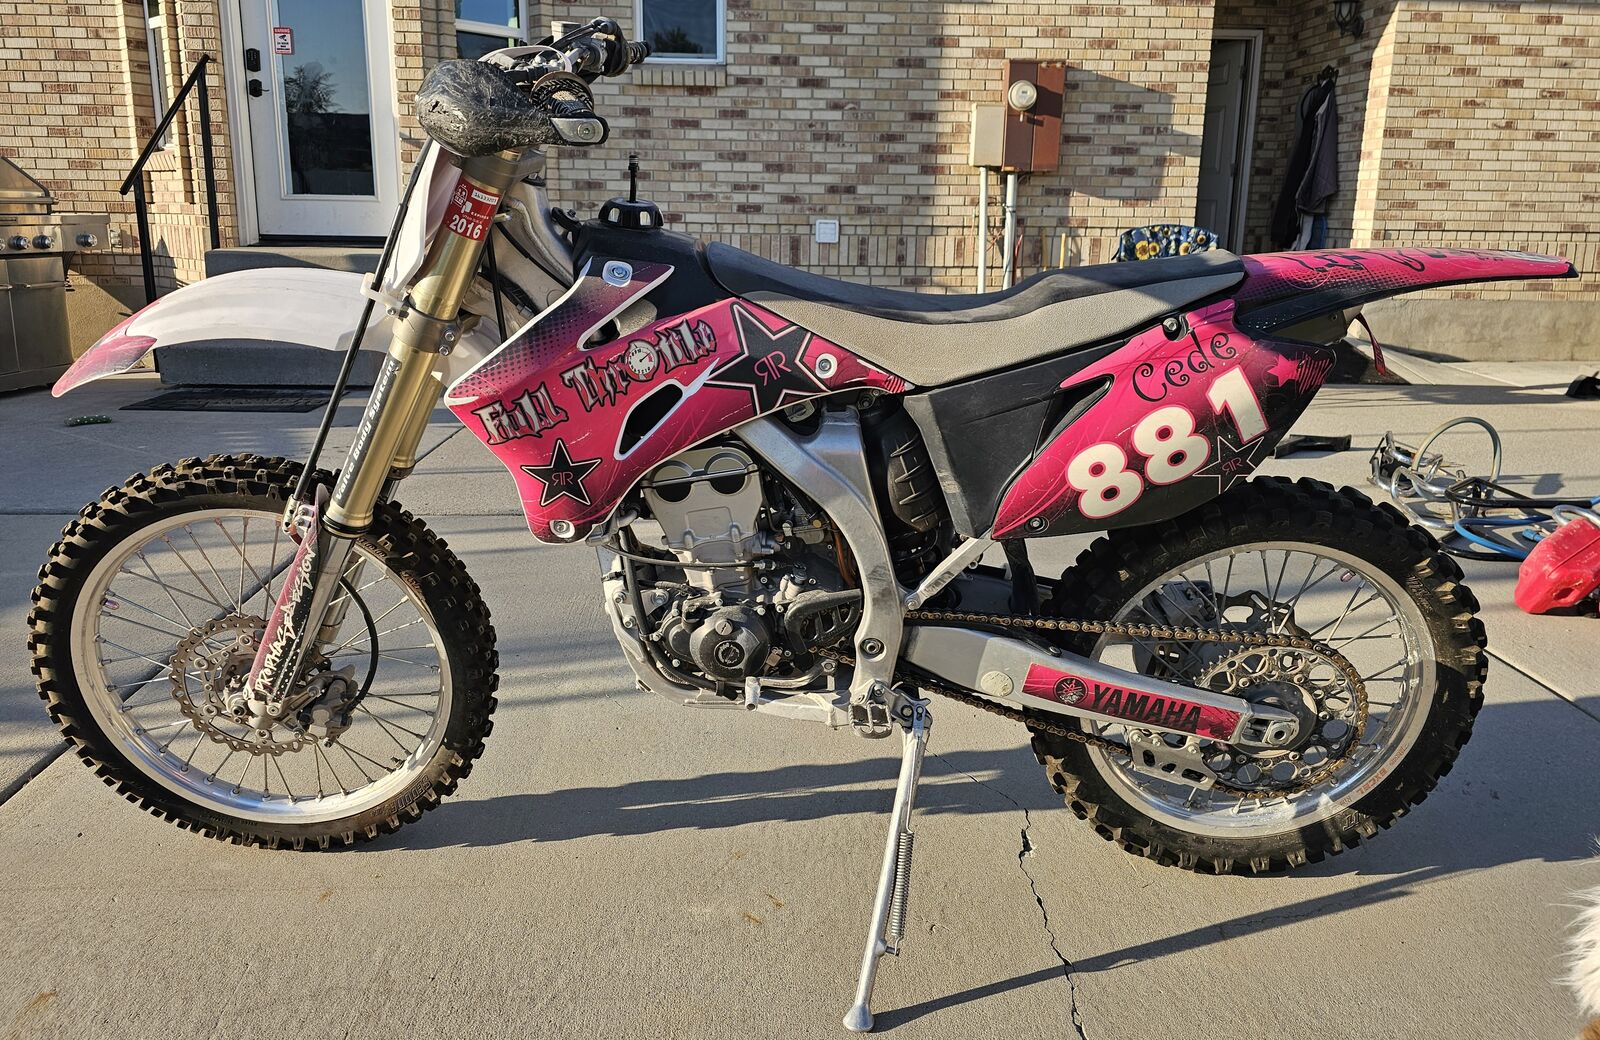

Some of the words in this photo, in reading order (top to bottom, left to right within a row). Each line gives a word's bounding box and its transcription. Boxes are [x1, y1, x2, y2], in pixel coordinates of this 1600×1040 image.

[449, 214, 483, 239] 2016
[1132, 328, 1237, 402] Cede
[335, 462, 356, 501] Valve
[352, 420, 373, 462] Body
[368, 360, 395, 420] System
[1065, 364, 1270, 519] 881
[1091, 683, 1202, 735] YAMAHA
